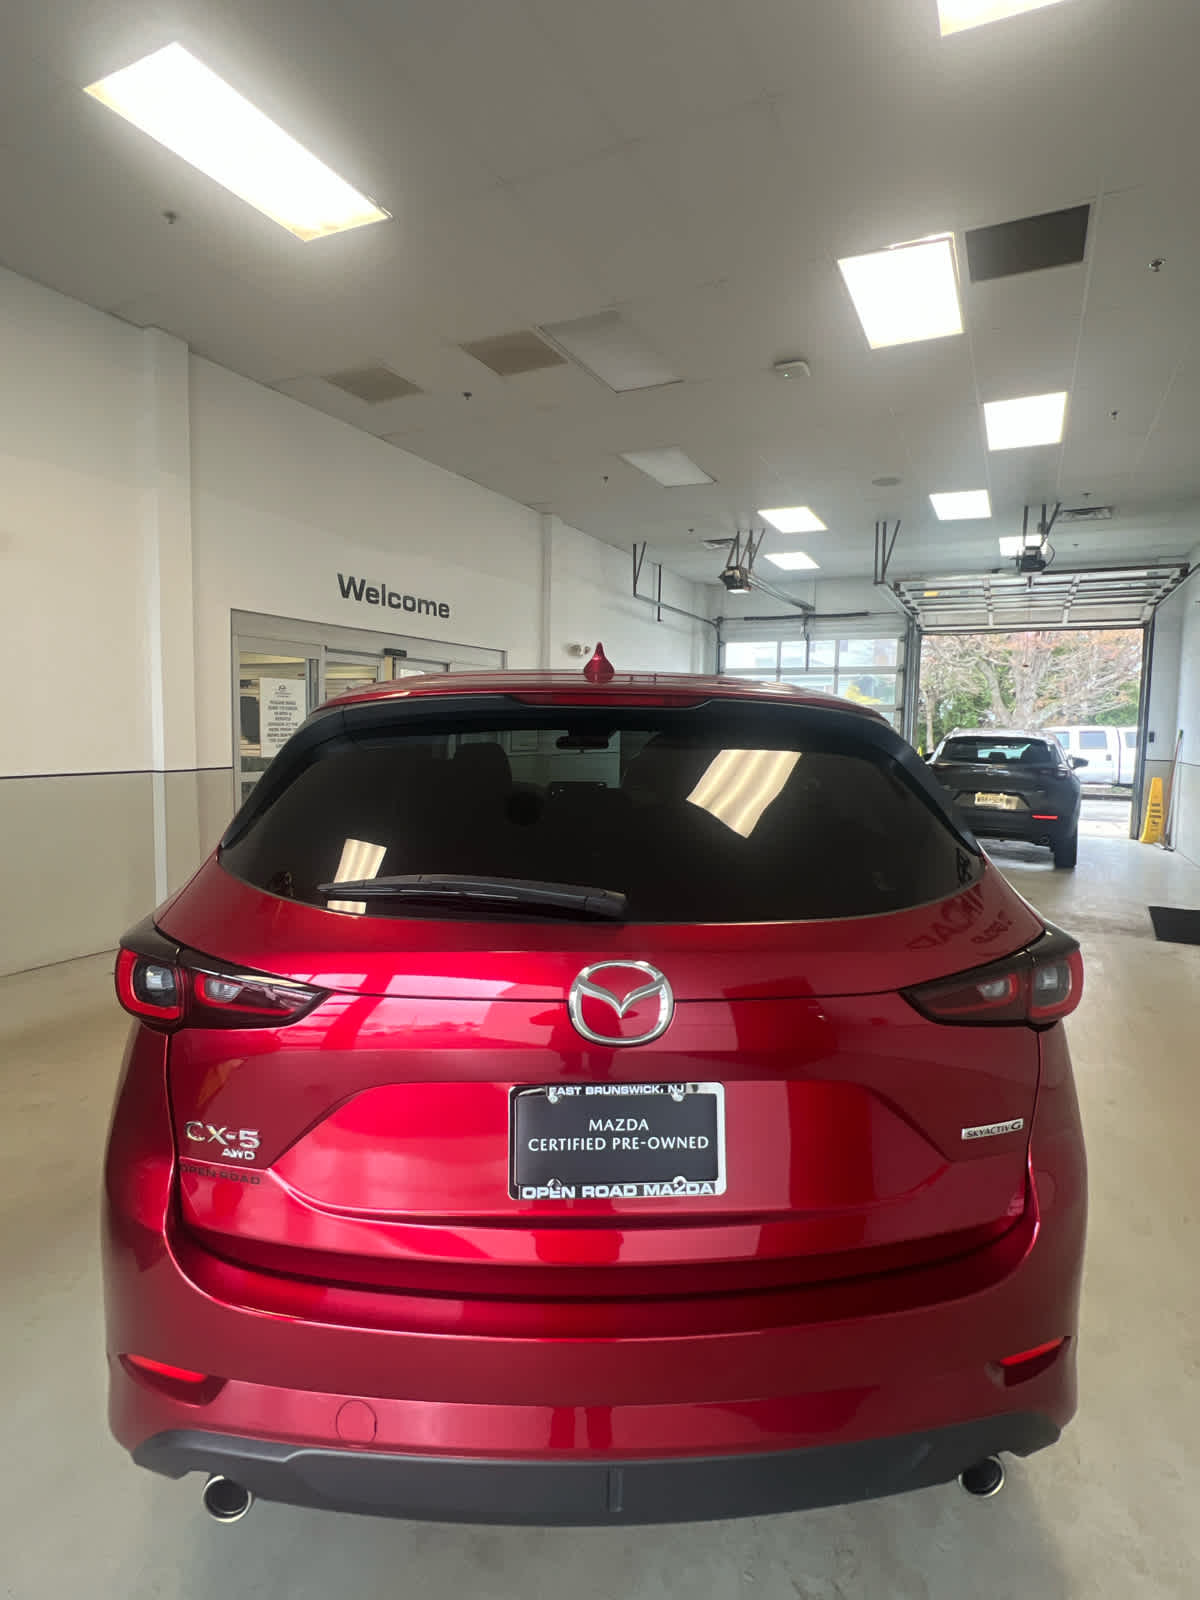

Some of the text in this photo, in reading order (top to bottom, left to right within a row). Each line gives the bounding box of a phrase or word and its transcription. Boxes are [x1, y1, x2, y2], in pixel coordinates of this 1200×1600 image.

[337, 572, 450, 619] Welcome
[549, 1086, 582, 1096] EAST
[588, 1118, 649, 1132] MAZDA
[185, 1120, 261, 1149] CX-5
[528, 1136, 709, 1152] CERTIFIED PRE-OWNED
[221, 1148, 256, 1161] AWD
[219, 1171, 261, 1185] ROAD
[522, 1183, 715, 1200] OPEN ROAD MAZDA
